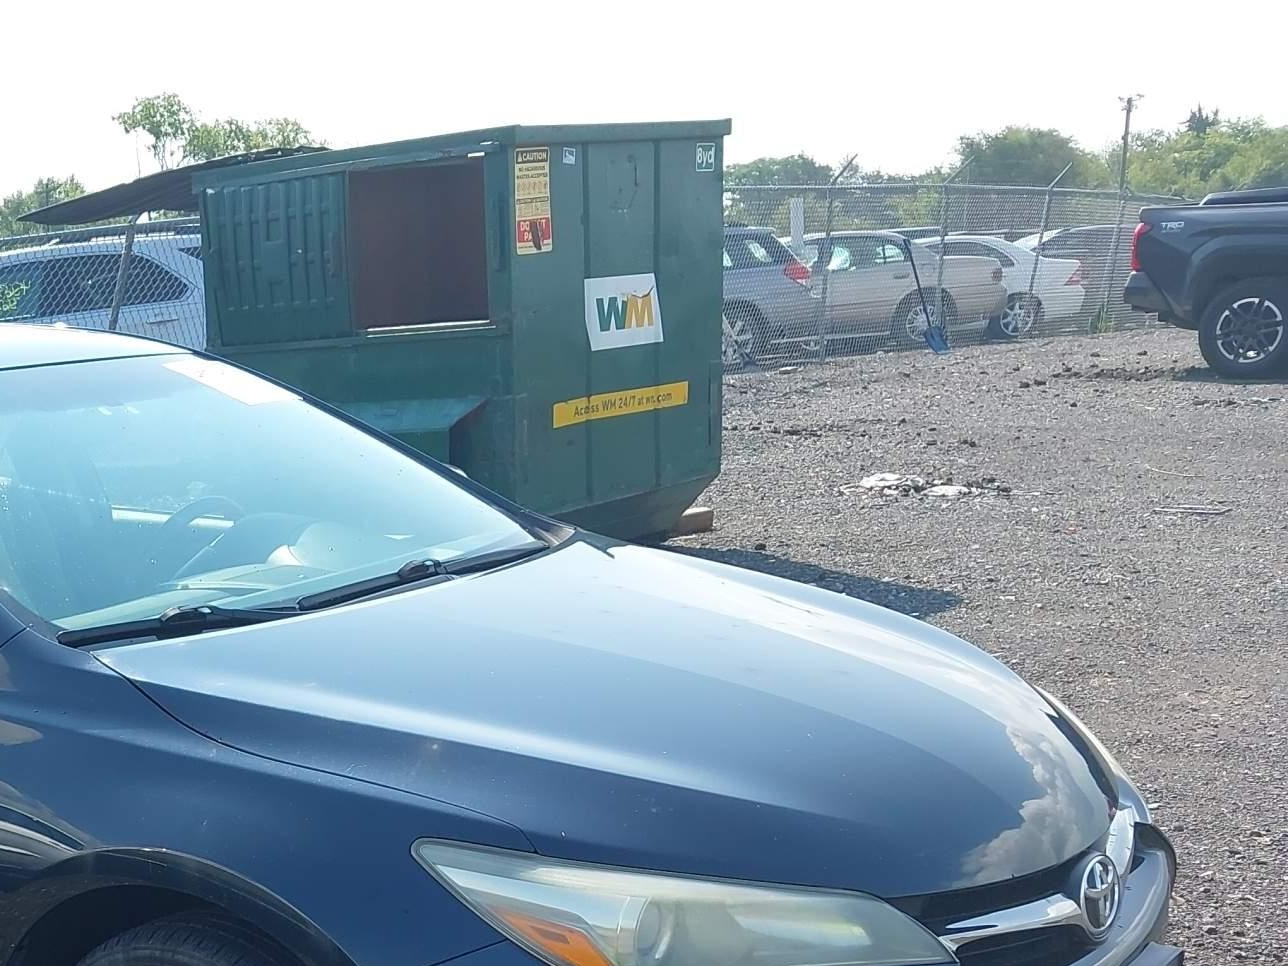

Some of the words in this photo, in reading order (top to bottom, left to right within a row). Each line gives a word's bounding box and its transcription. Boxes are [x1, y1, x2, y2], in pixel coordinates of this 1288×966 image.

[522, 151, 547, 161] CAUTION
[520, 221, 530, 231] DO
[596, 294, 654, 332] WM
[618, 395, 636, 409] 24/7
